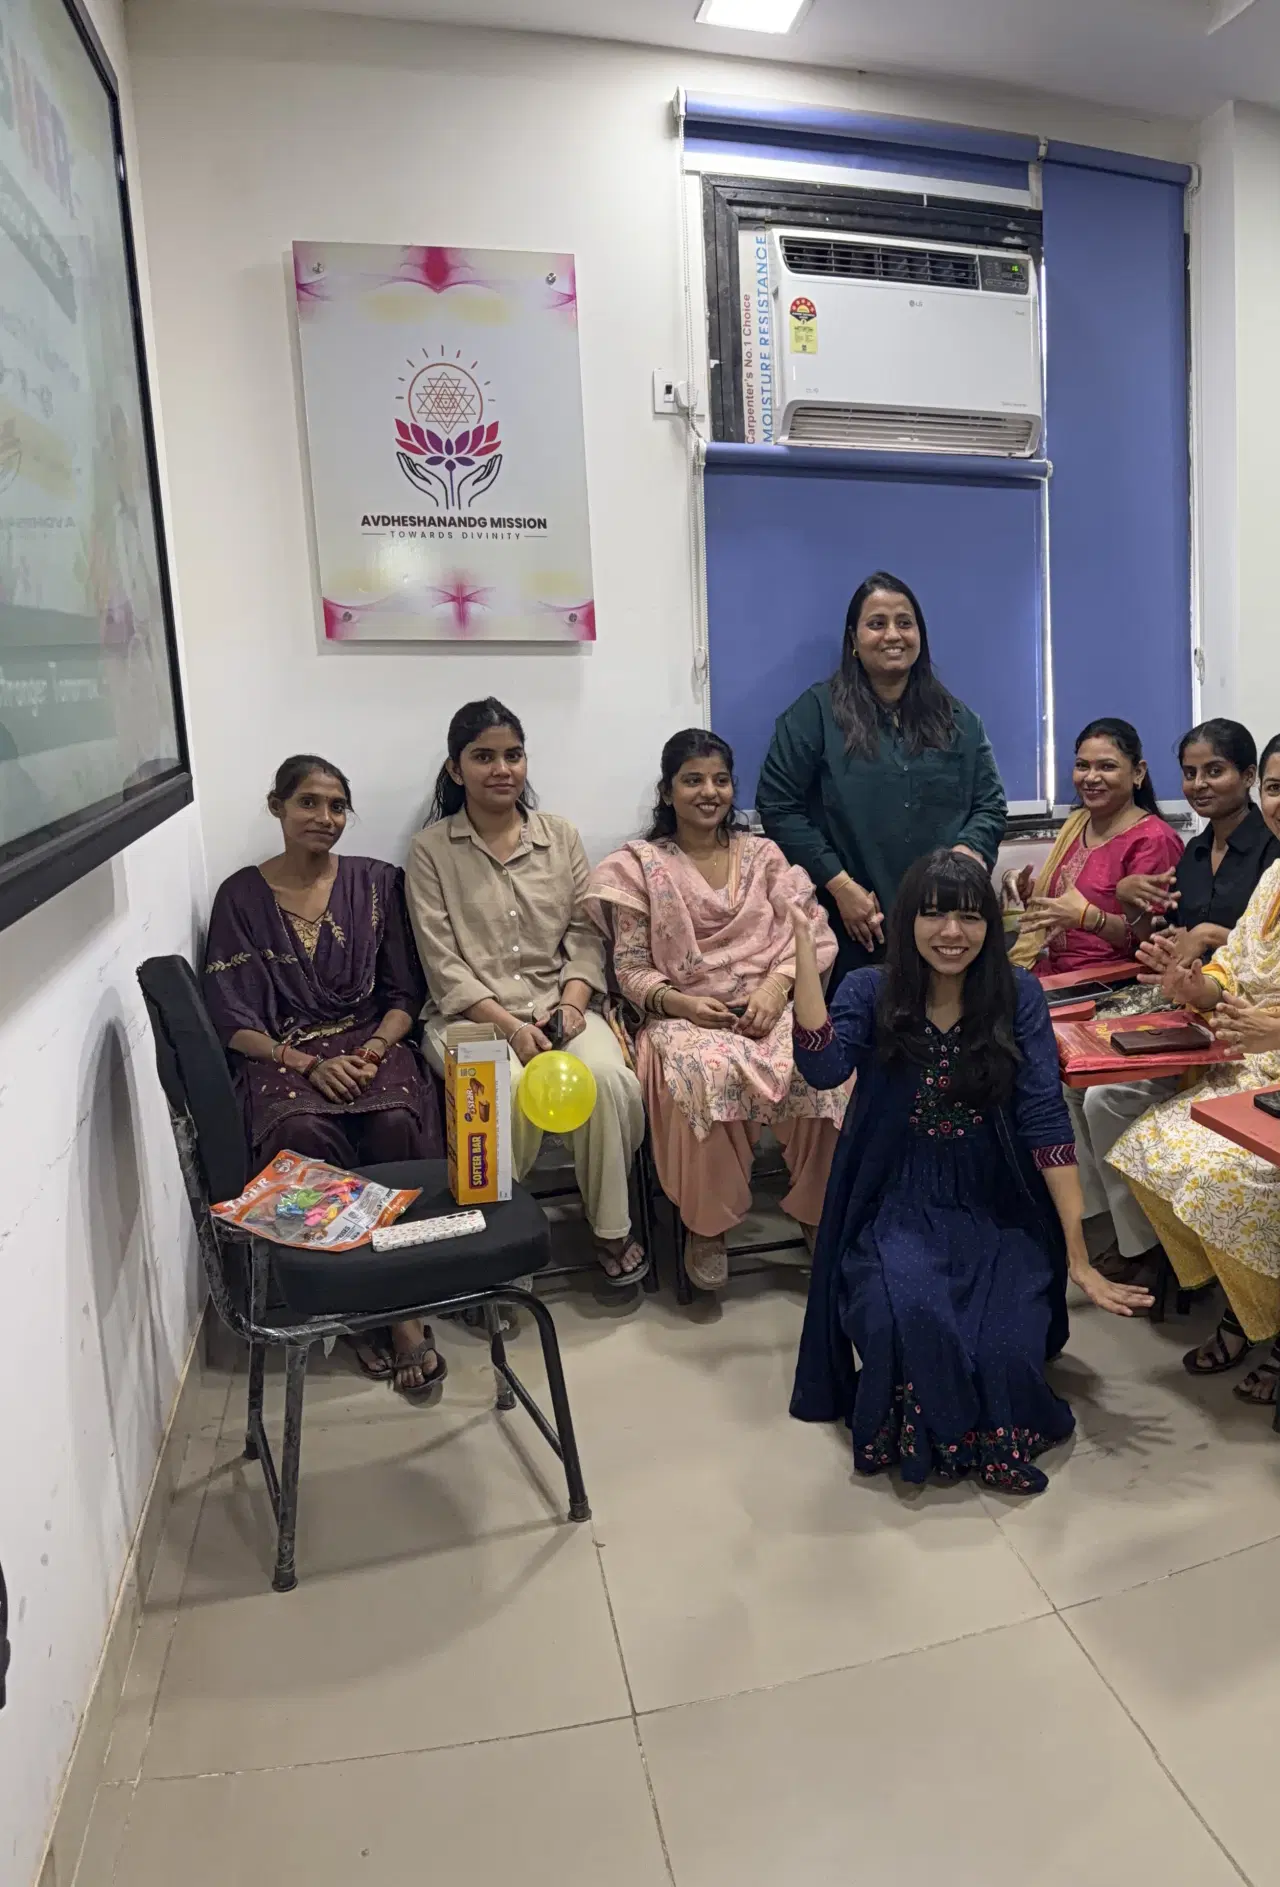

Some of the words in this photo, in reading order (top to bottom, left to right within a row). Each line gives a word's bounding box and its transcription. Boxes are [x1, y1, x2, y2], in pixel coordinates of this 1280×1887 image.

[755, 235, 770, 346] RESISTANCE
[742, 294, 751, 337] Choice
[745, 372, 755, 444] Carpenter's
[760, 352, 773, 443] MOISTURE
[361, 515, 488, 528] AVDHESHANANDG
[490, 517, 548, 529] MISSION
[390, 531, 454, 539] TOWARDS
[462, 532, 521, 540] DIVINITY
[472, 1136, 482, 1154] BAR
[472, 1155, 483, 1186] SOFTER
